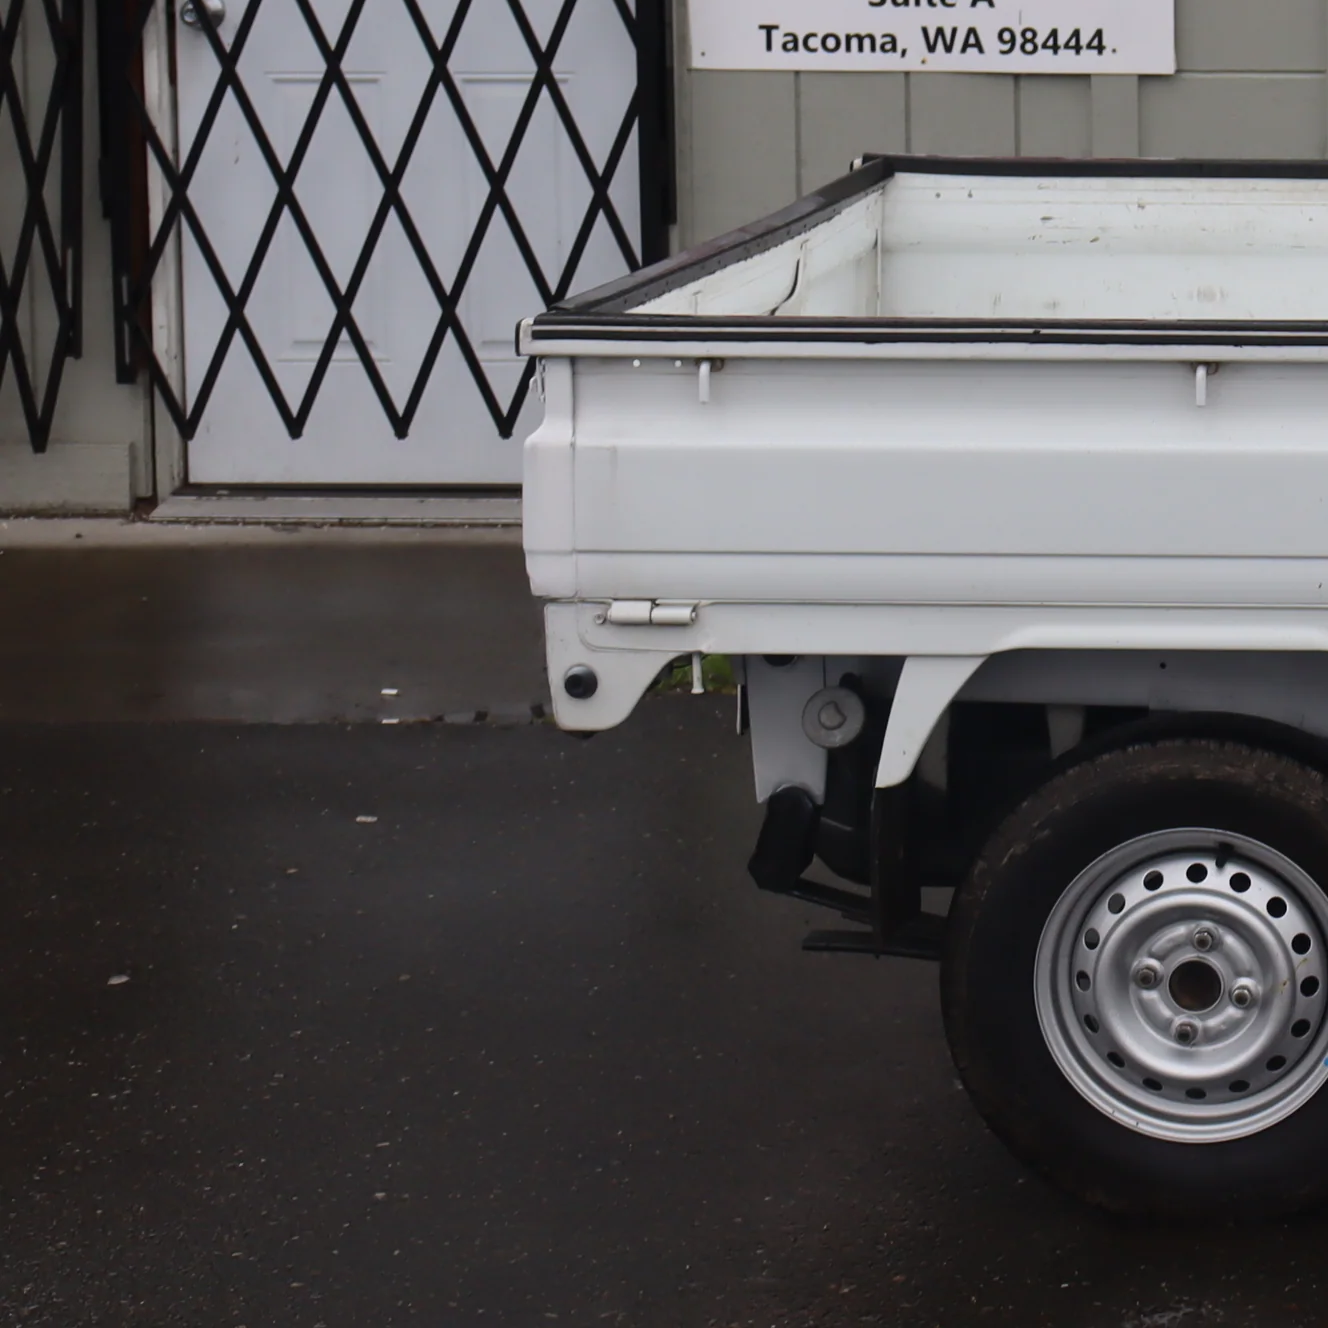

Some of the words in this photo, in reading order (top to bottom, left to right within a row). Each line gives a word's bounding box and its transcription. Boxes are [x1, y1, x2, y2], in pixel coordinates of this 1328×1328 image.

[758, 24, 907, 58] Tacoma,
[921, 26, 985, 54] WA
[997, 27, 1117, 56] 98444.
